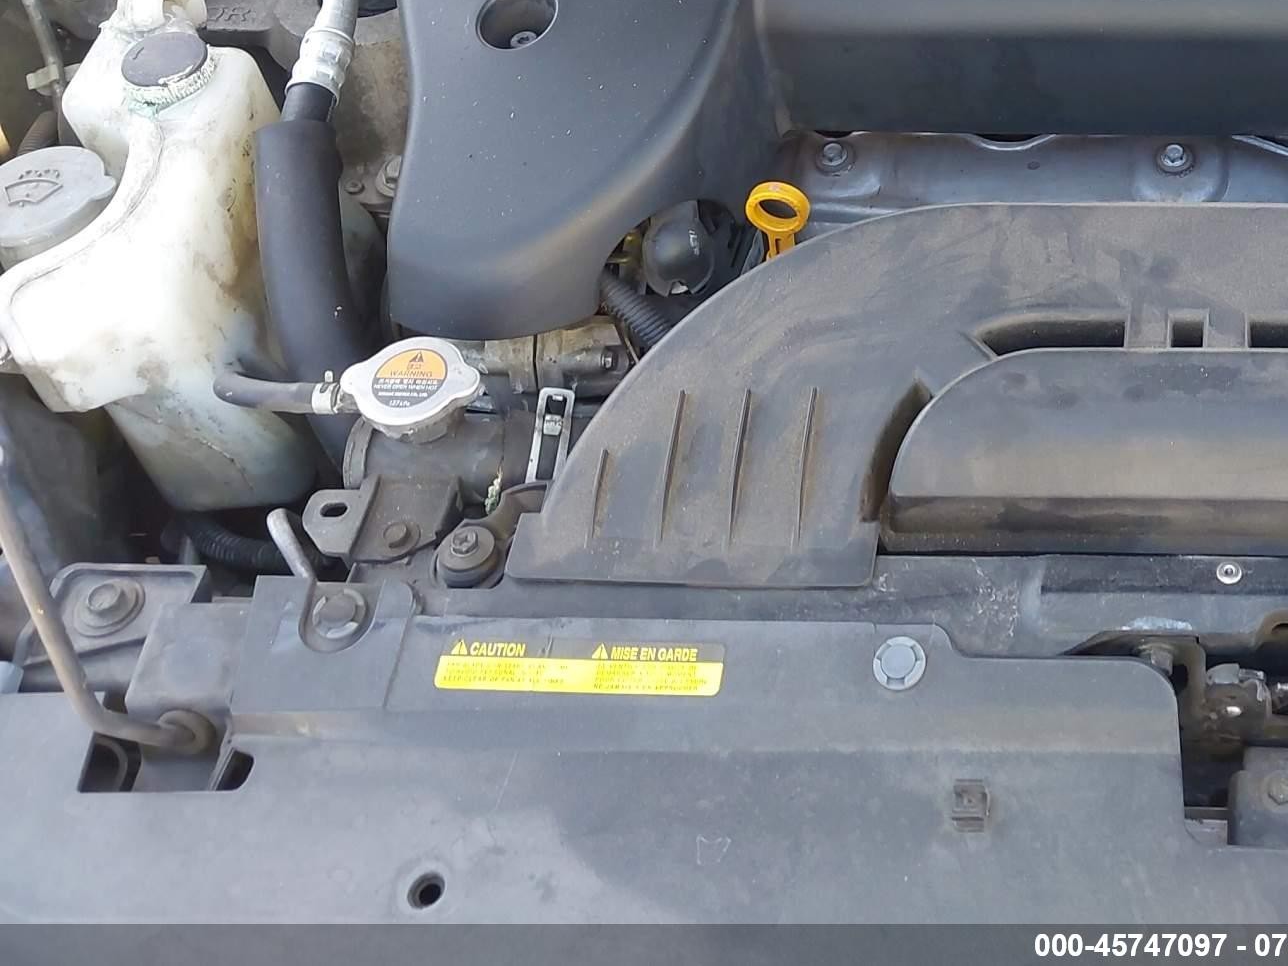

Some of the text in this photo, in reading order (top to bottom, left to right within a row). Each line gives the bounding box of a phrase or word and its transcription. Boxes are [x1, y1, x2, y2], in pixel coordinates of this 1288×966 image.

[469, 642, 526, 657] CAUTION
[610, 645, 698, 663] MISE EN GARDE
